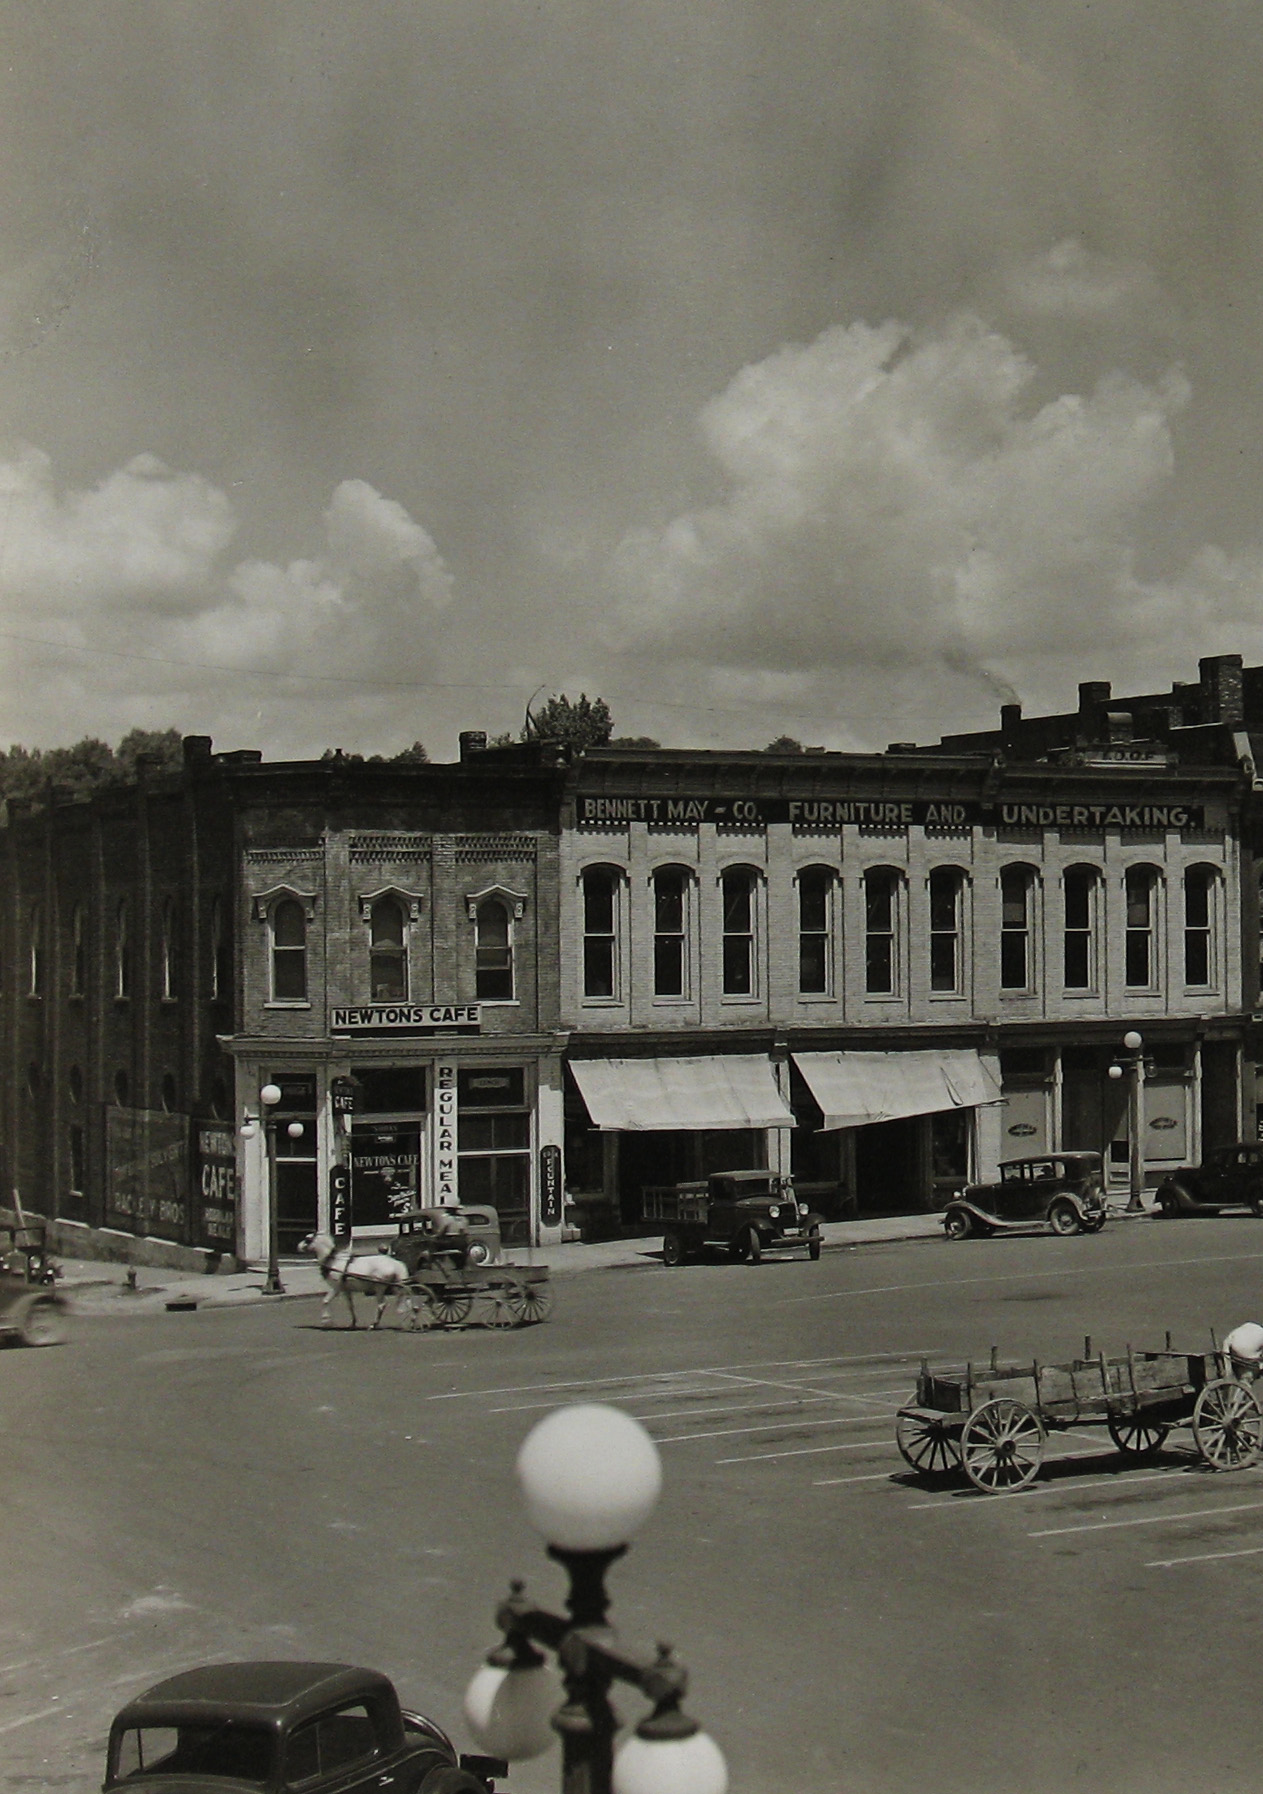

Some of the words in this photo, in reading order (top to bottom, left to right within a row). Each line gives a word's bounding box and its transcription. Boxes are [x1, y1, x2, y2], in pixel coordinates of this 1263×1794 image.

[584, 799, 661, 819] BENNETT
[667, 800, 709, 820] MAY
[732, 801, 763, 821] CO.
[789, 801, 914, 823] FURNITURE
[925, 803, 966, 824] AND
[1002, 805, 1196, 828] UNDERTAKING.
[335, 1008, 423, 1025] NEWTONS
[429, 1007, 478, 1022] CAFE
[439, 1067, 453, 1151] REGULAR
[201, 1163, 235, 1200] CAFE
[546, 1158, 556, 1216] FOUNTAIN
[334, 1176, 346, 1236] CAFE
